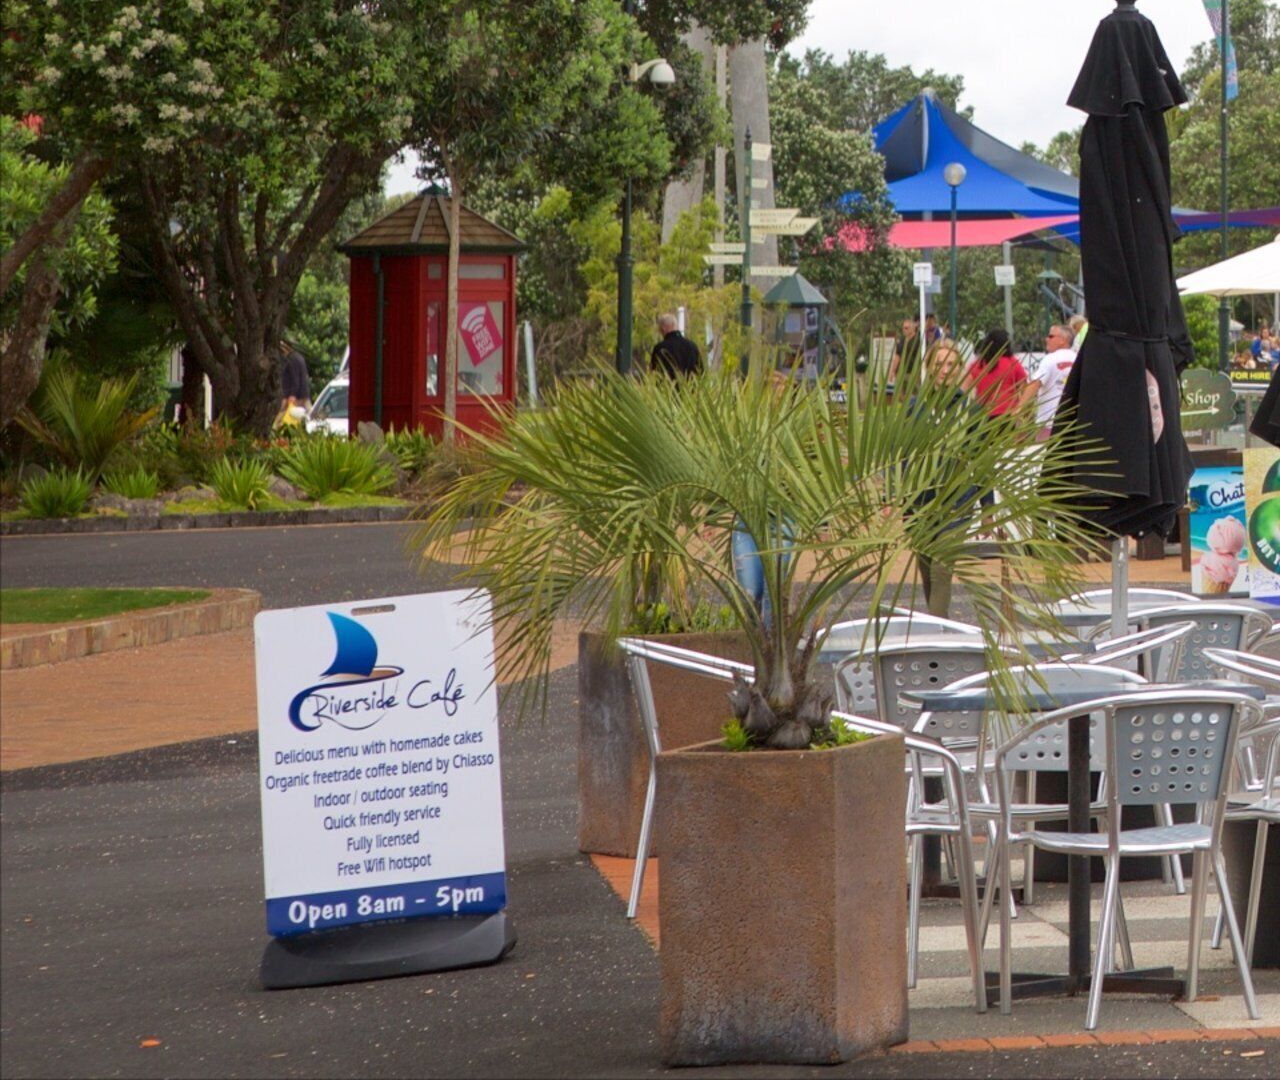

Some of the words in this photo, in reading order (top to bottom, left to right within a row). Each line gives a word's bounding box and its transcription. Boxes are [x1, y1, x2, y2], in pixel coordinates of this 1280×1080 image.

[1230, 371, 1249, 380] FOR
[1250, 371, 1272, 380] HIRE
[1256, 538, 1275, 558] BUY
[309, 682, 399, 724] Riverside
[407, 668, 467, 717] Café
[275, 748, 324, 765] Delicious
[328, 745, 358, 760] menu
[362, 741, 386, 755] with
[390, 734, 450, 752] homemade
[453, 731, 483, 745] cakes
[265, 774, 310, 793] Organic
[313, 765, 362, 784] freetrade
[365, 762, 399, 778] coffee
[402, 758, 433, 774] blend
[436, 757, 450, 774] by
[453, 752, 494, 769] Chiasso
[314, 792, 351, 808] Indoor
[361, 786, 406, 802] outdoor
[409, 781, 449, 797] seating
[323, 815, 356, 831] Quick
[359, 809, 401, 827] friendly
[404, 805, 441, 820] service
[347, 836, 372, 853] Fully
[376, 830, 420, 849] licensed
[337, 862, 361, 876] Free
[364, 857, 385, 873] Wifi
[389, 853, 432, 872] hotspot
[288, 900, 348, 928] Open
[357, 894, 405, 916] 8am
[435, 885, 485, 911] 5pm
